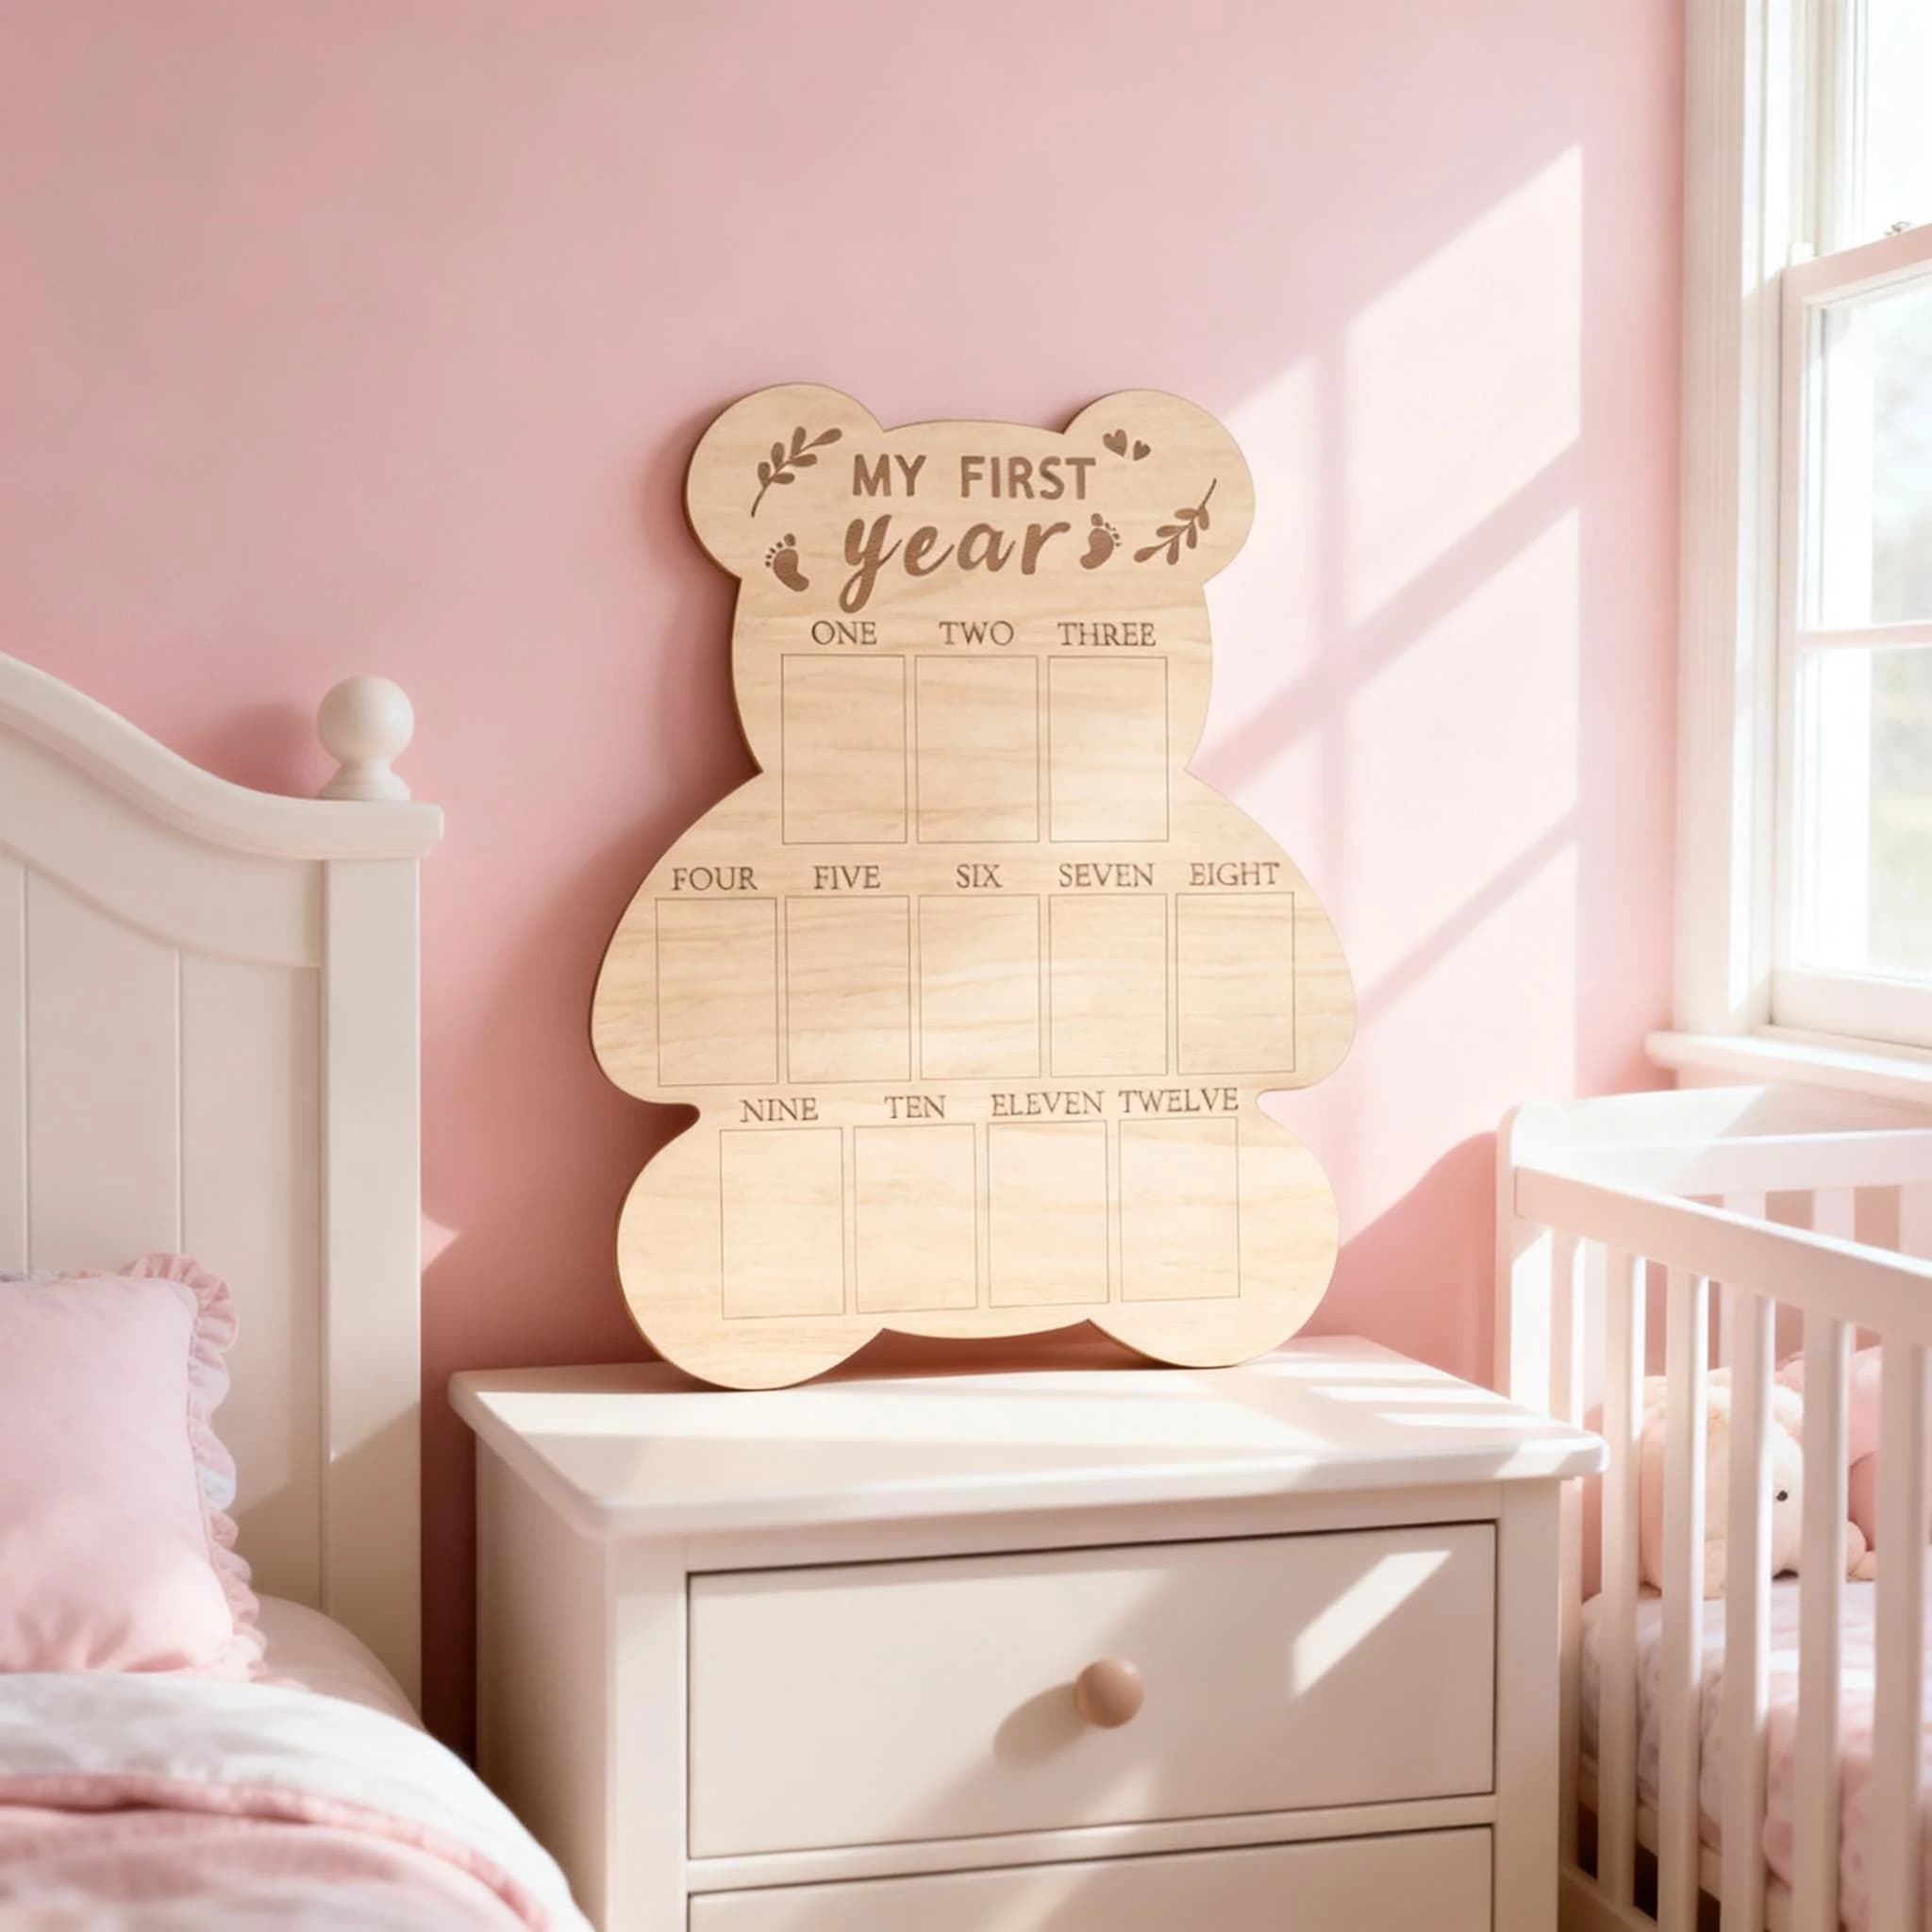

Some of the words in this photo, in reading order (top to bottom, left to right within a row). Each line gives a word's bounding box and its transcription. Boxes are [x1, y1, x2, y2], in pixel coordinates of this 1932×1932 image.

[851, 453, 927, 498] MY
[959, 456, 1097, 501] FIRST
[838, 513, 1072, 614] year
[809, 620, 878, 646] ONE
[938, 620, 1015, 646] TWO
[1057, 622, 1158, 647] THREE
[671, 866, 759, 891] FOUR
[812, 864, 882, 891] FIVE
[955, 863, 1004, 890] SIX
[1058, 862, 1156, 889] SEVEN
[1188, 861, 1281, 887] EIGHT
[740, 1096, 819, 1124] NINE
[884, 1094, 947, 1120] TEN
[991, 1091, 1105, 1118] ELEVEN
[1118, 1087, 1240, 1114] TWELVE
